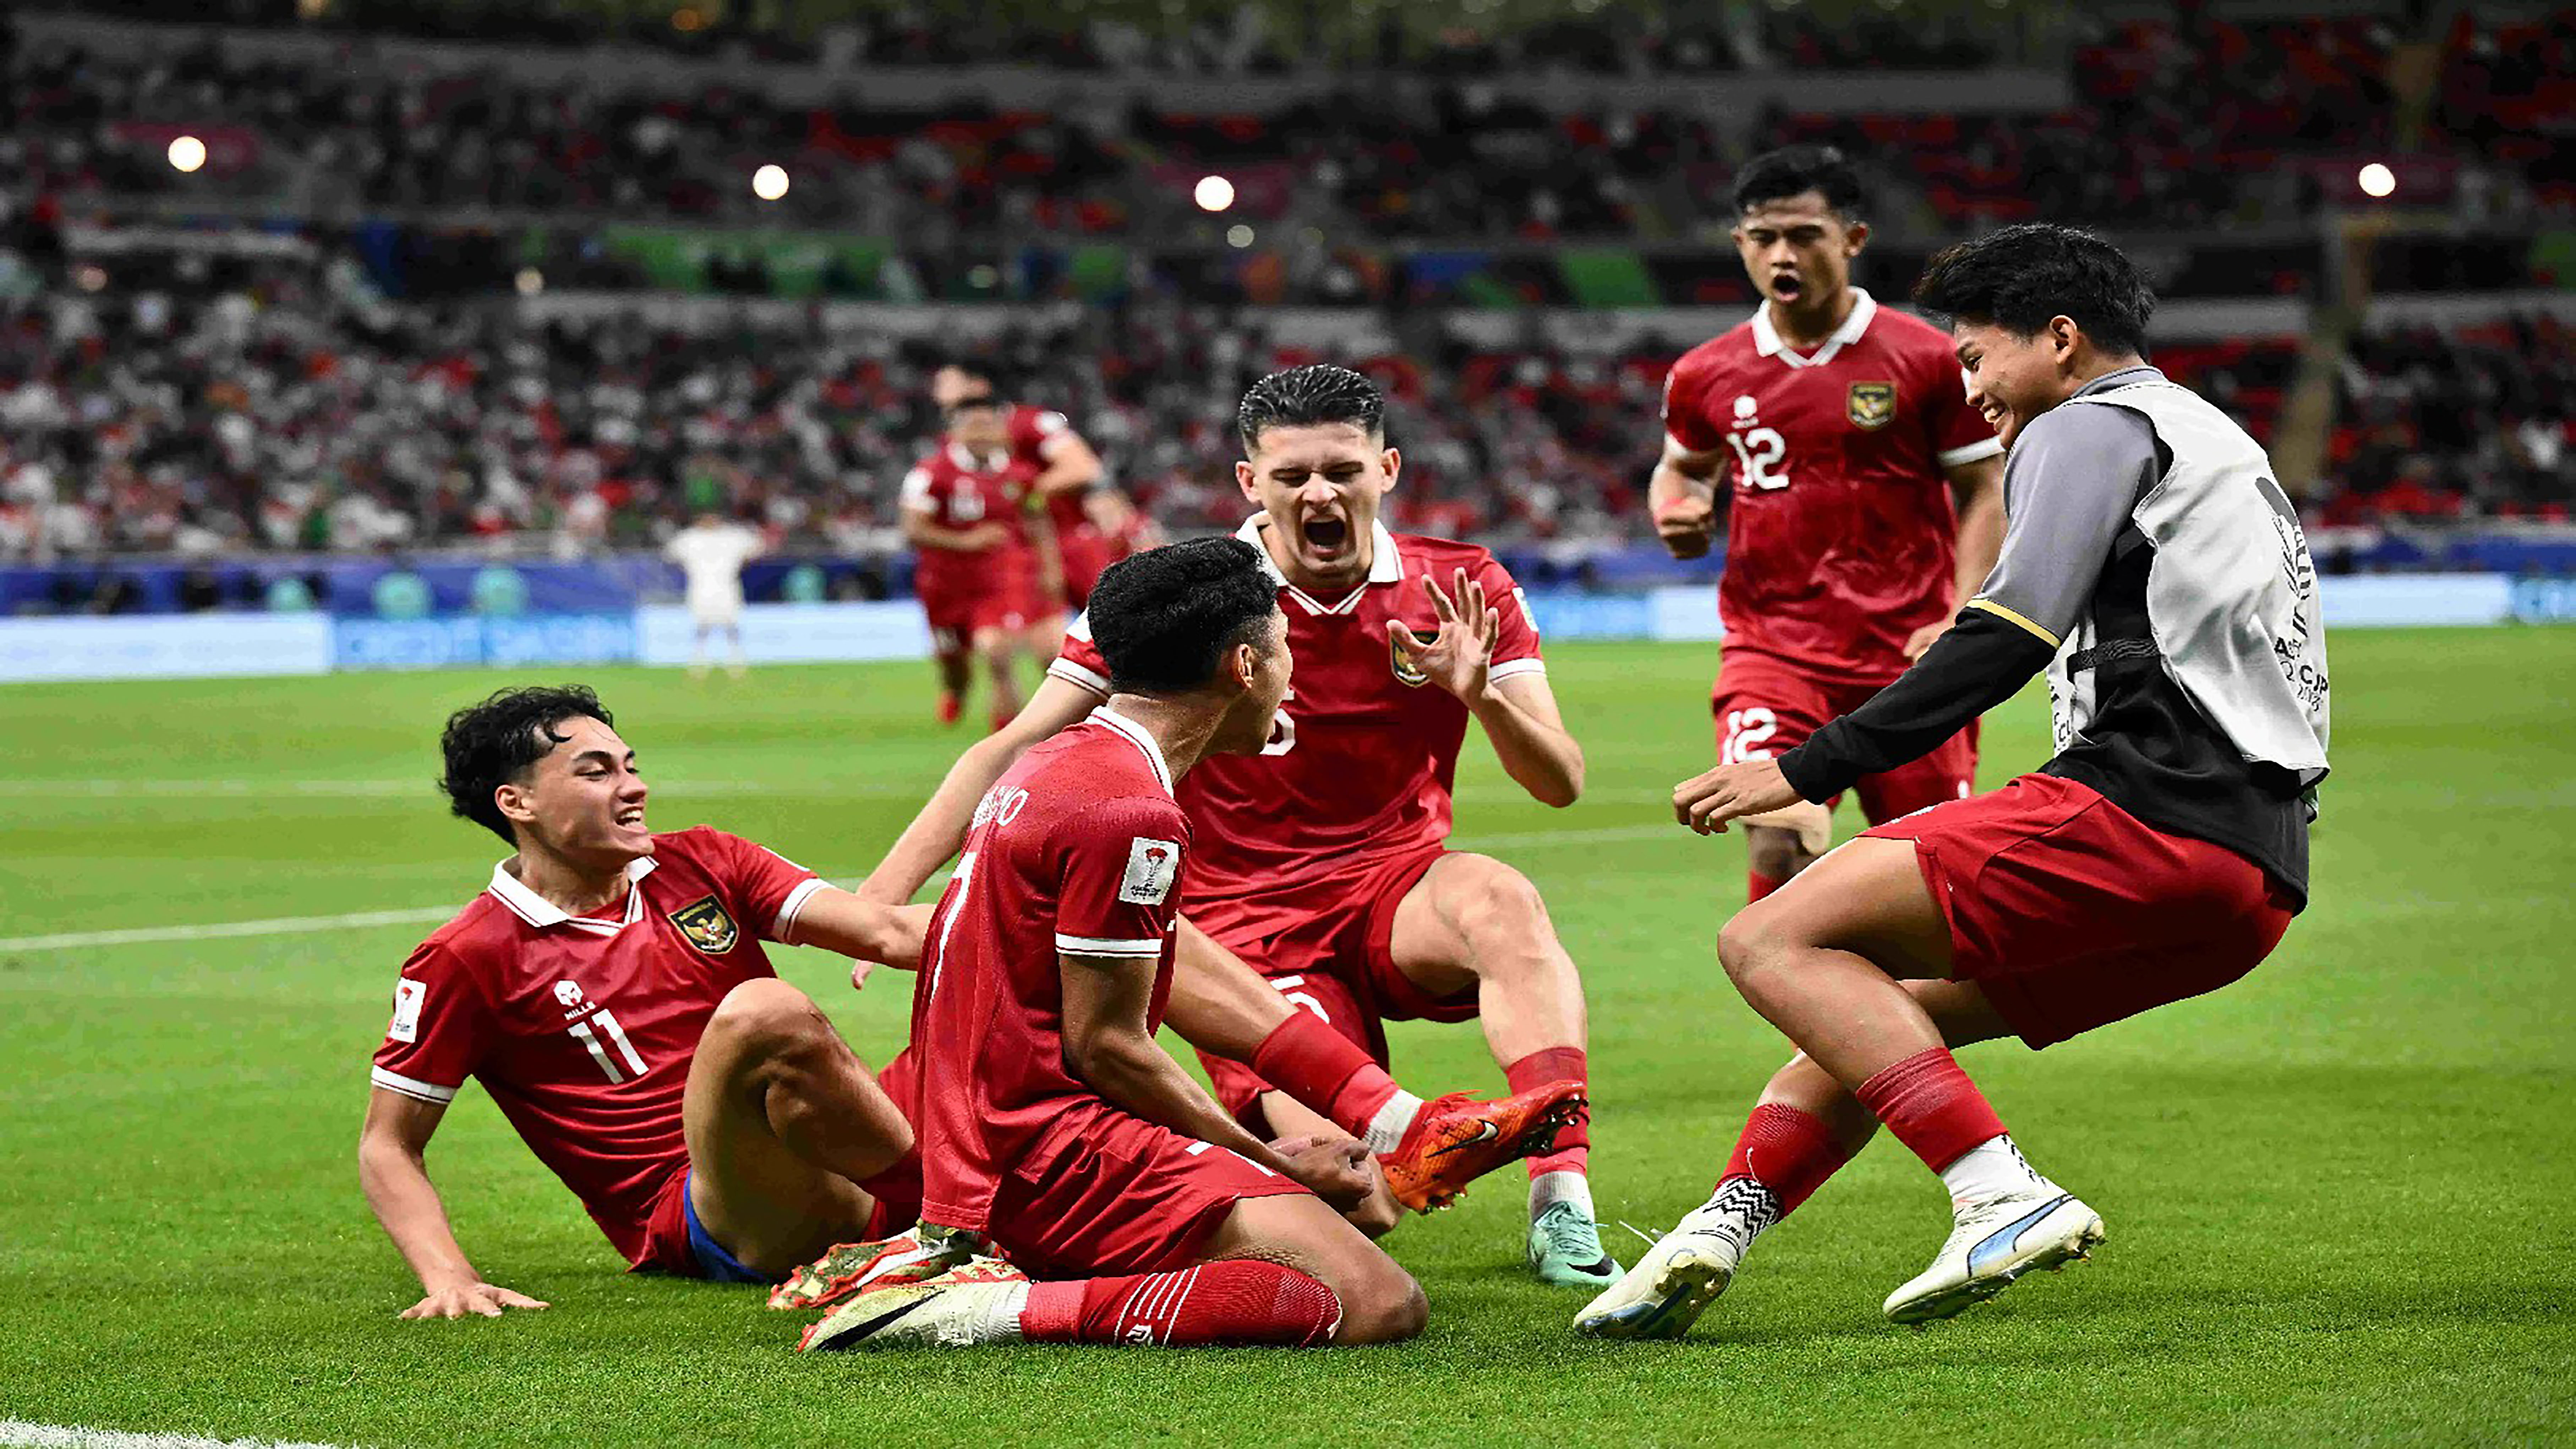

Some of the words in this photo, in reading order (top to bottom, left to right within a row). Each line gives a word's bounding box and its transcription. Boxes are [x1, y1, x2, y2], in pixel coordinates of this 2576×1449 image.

[1726, 427, 1789, 490] 12
[1722, 707, 1777, 765] 12
[564, 1000, 596, 1021] MILLS
[567, 1007, 649, 1085] 11
